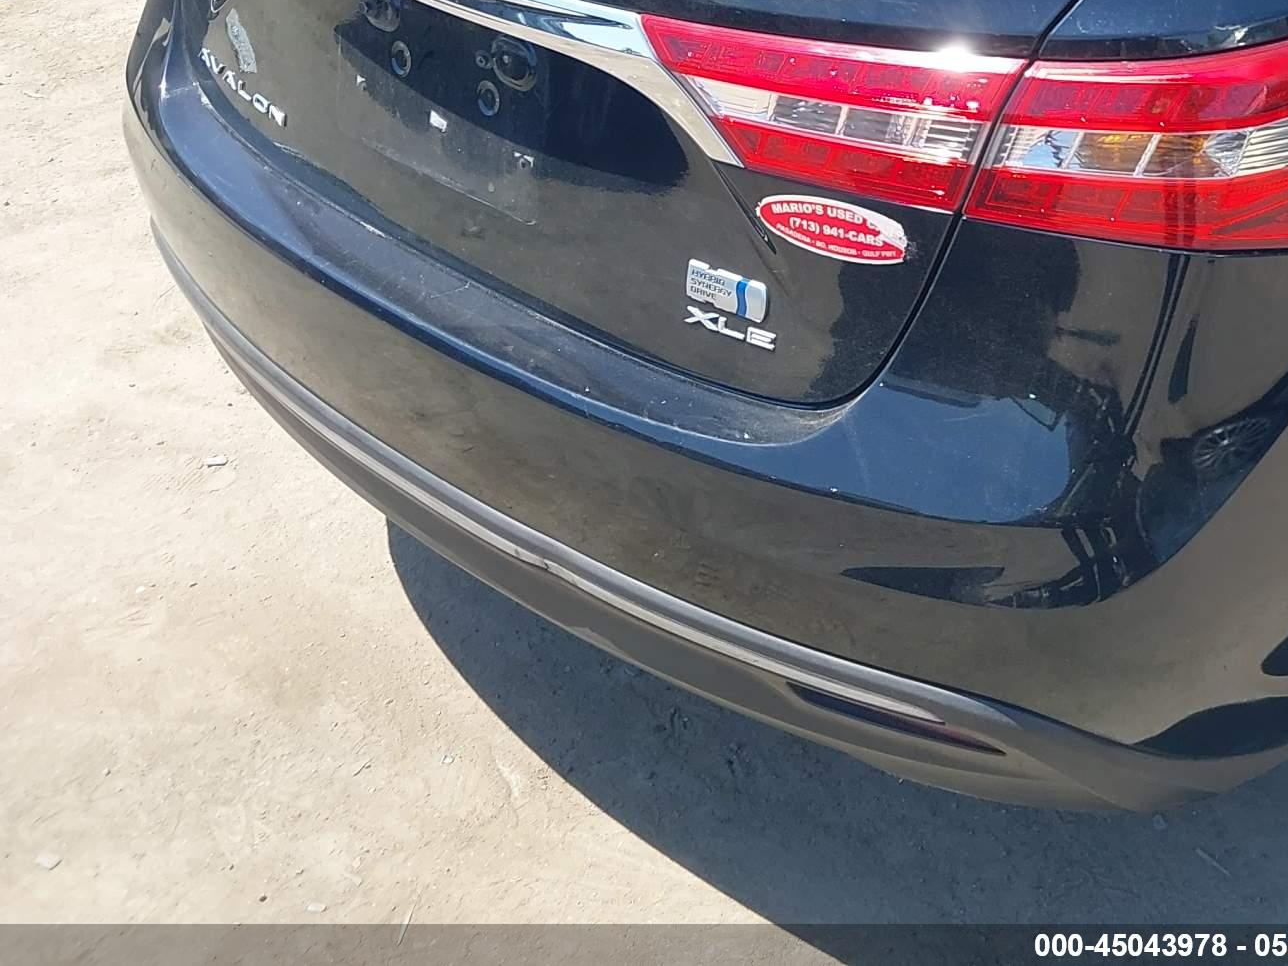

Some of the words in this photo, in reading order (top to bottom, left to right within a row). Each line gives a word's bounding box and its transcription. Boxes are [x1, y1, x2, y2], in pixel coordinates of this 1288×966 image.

[198, 48, 287, 127] AVALON
[771, 202, 824, 215] MARIO'S
[826, 206, 863, 224] USED
[789, 216, 821, 235] (713)
[822, 224, 884, 247] 941-CARS
[690, 277, 732, 296] SYNERGY
[691, 269, 726, 286] HYBRID
[690, 285, 717, 300] DRIVE
[683, 305, 777, 351] XLE
